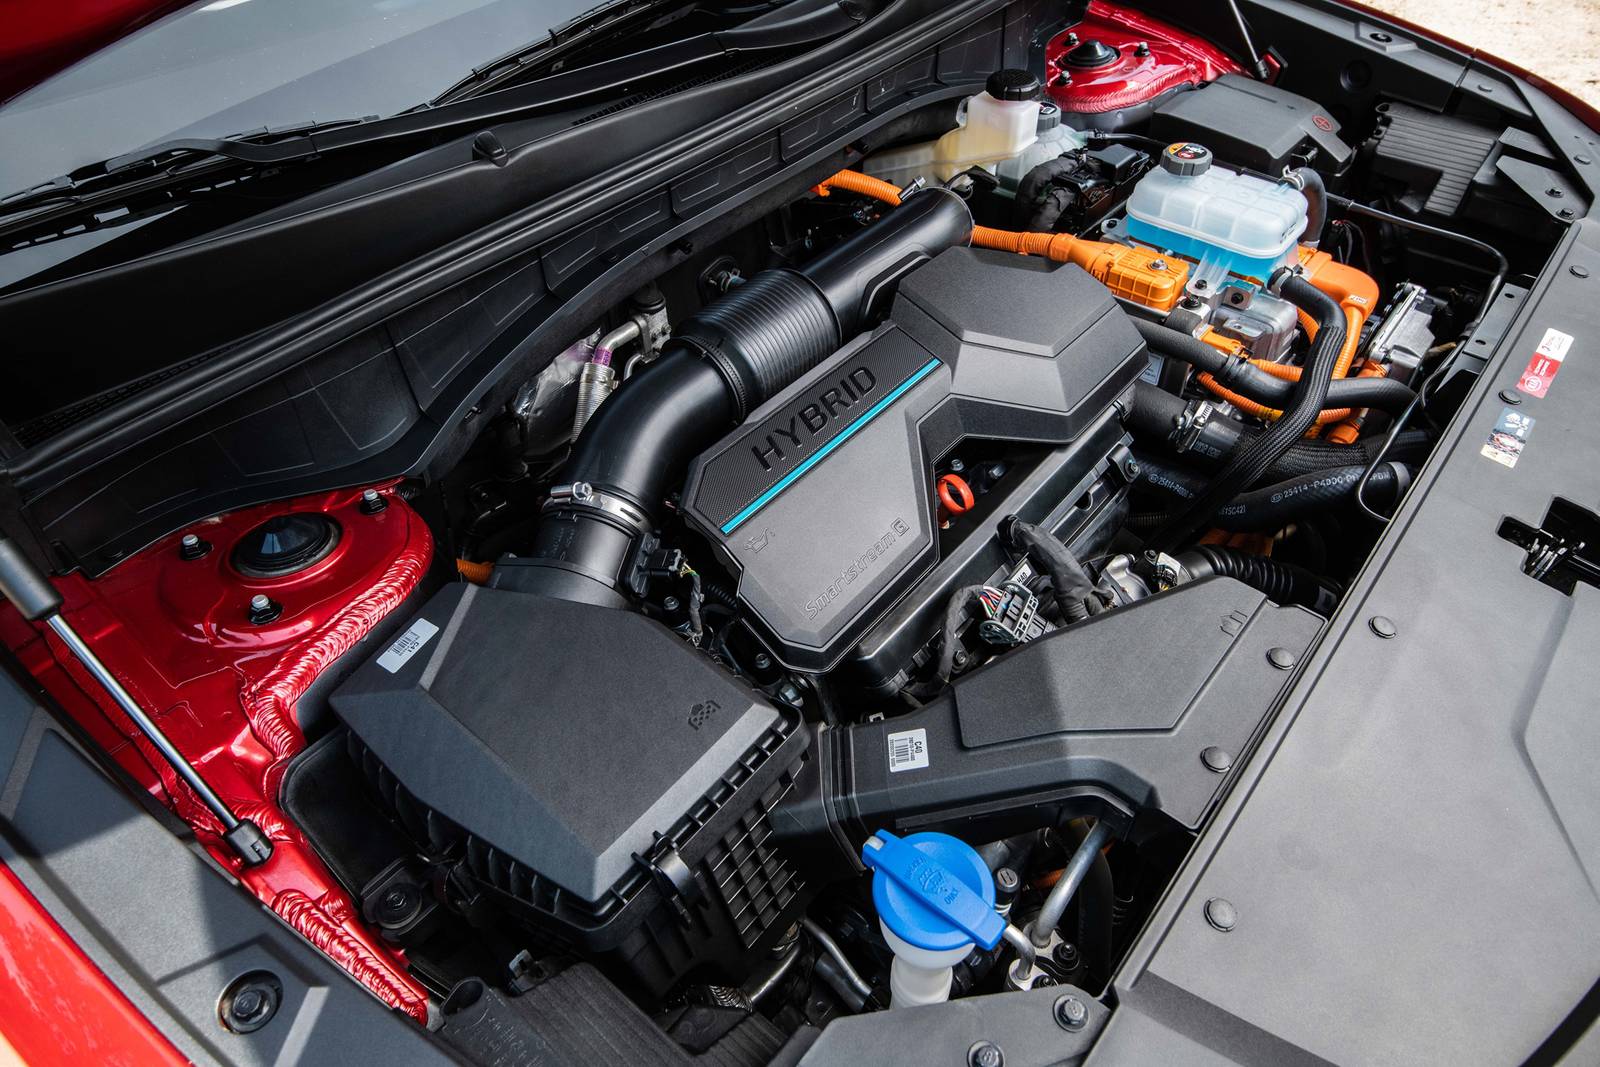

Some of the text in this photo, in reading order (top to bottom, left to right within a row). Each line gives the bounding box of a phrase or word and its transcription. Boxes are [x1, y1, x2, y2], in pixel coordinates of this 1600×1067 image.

[751, 366, 877, 472] HYBRID
[804, 517, 910, 621] Smartstream G
